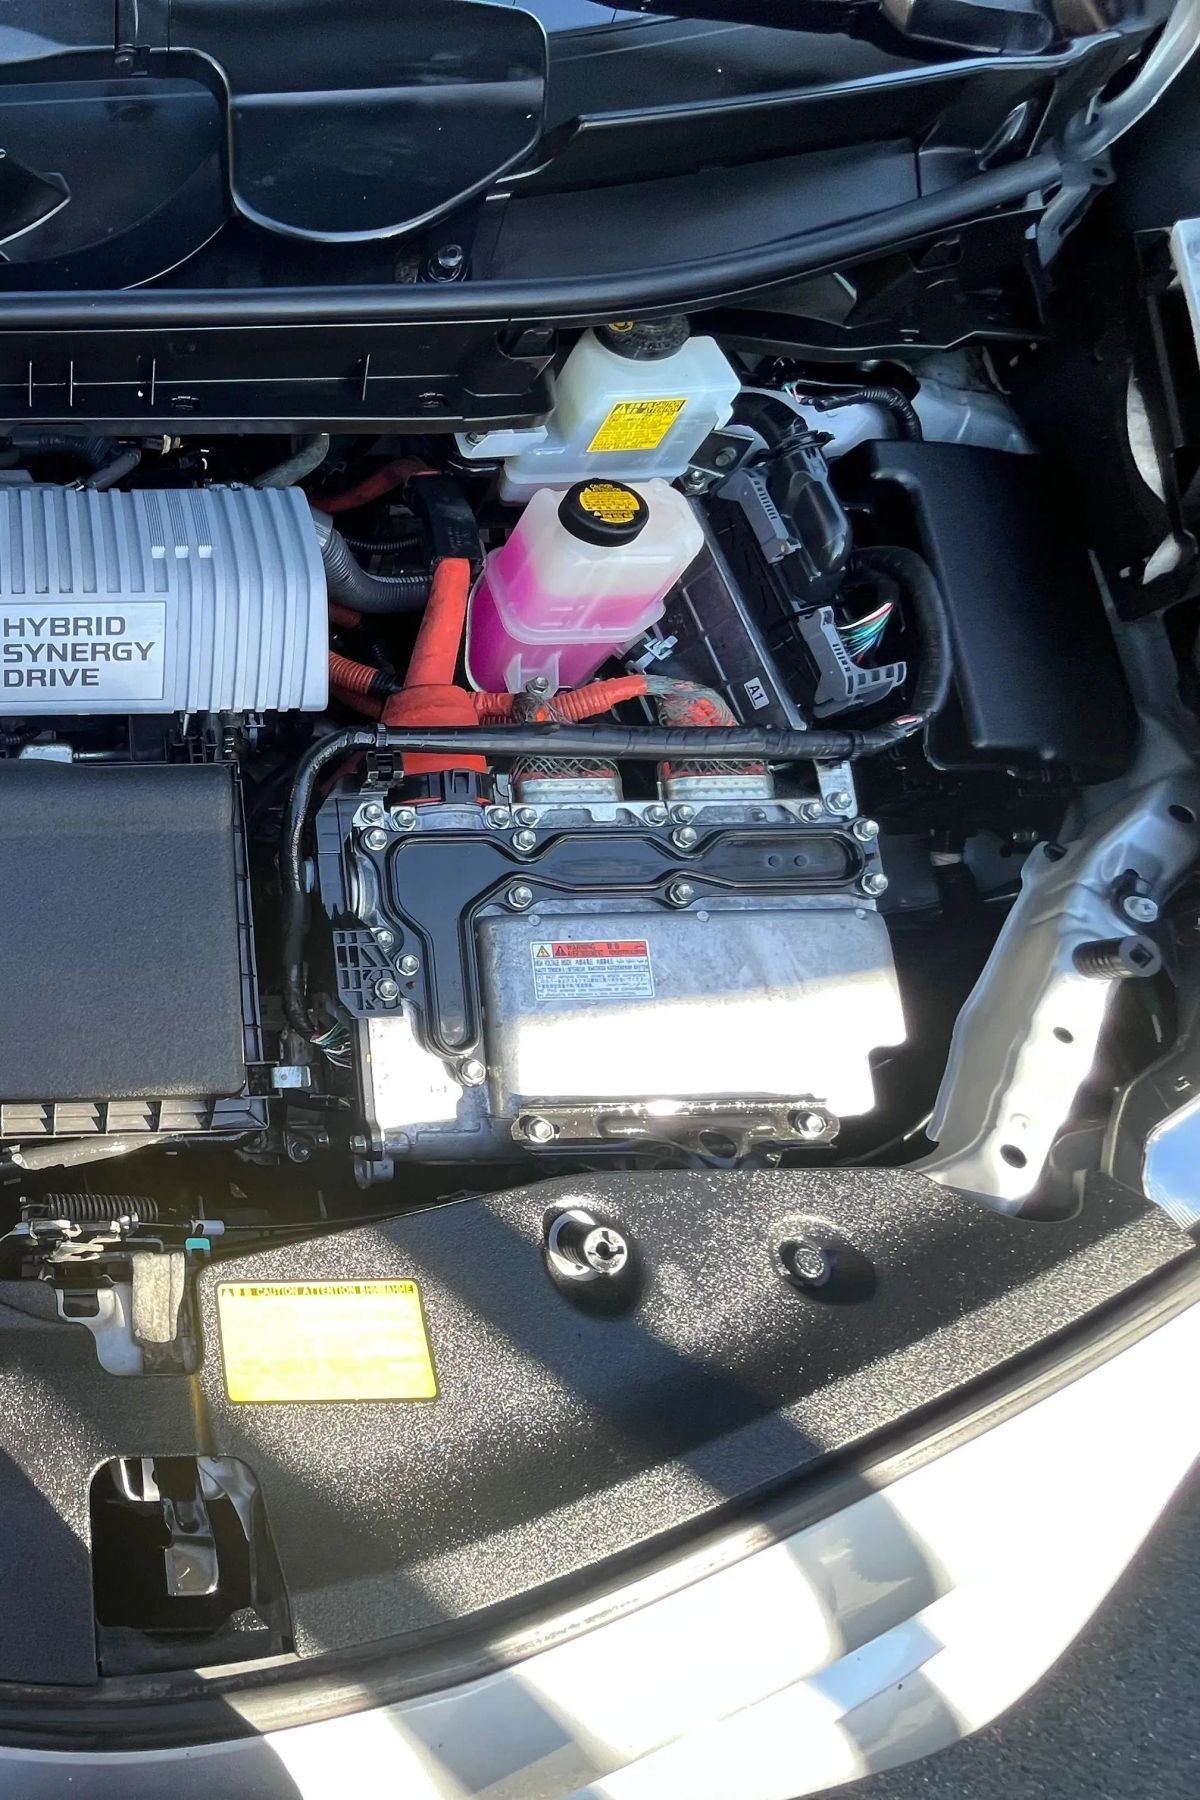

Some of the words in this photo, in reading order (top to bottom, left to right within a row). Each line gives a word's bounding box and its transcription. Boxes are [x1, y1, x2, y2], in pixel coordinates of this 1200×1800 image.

[3, 616, 126, 637] HYBRID
[3, 642, 155, 663] SYNERGY
[3, 668, 99, 687] DRIVE
[749, 686, 764, 700] A1
[256, 1286, 298, 1296] CAUTION
[303, 1286, 355, 1296] ATTENTION
